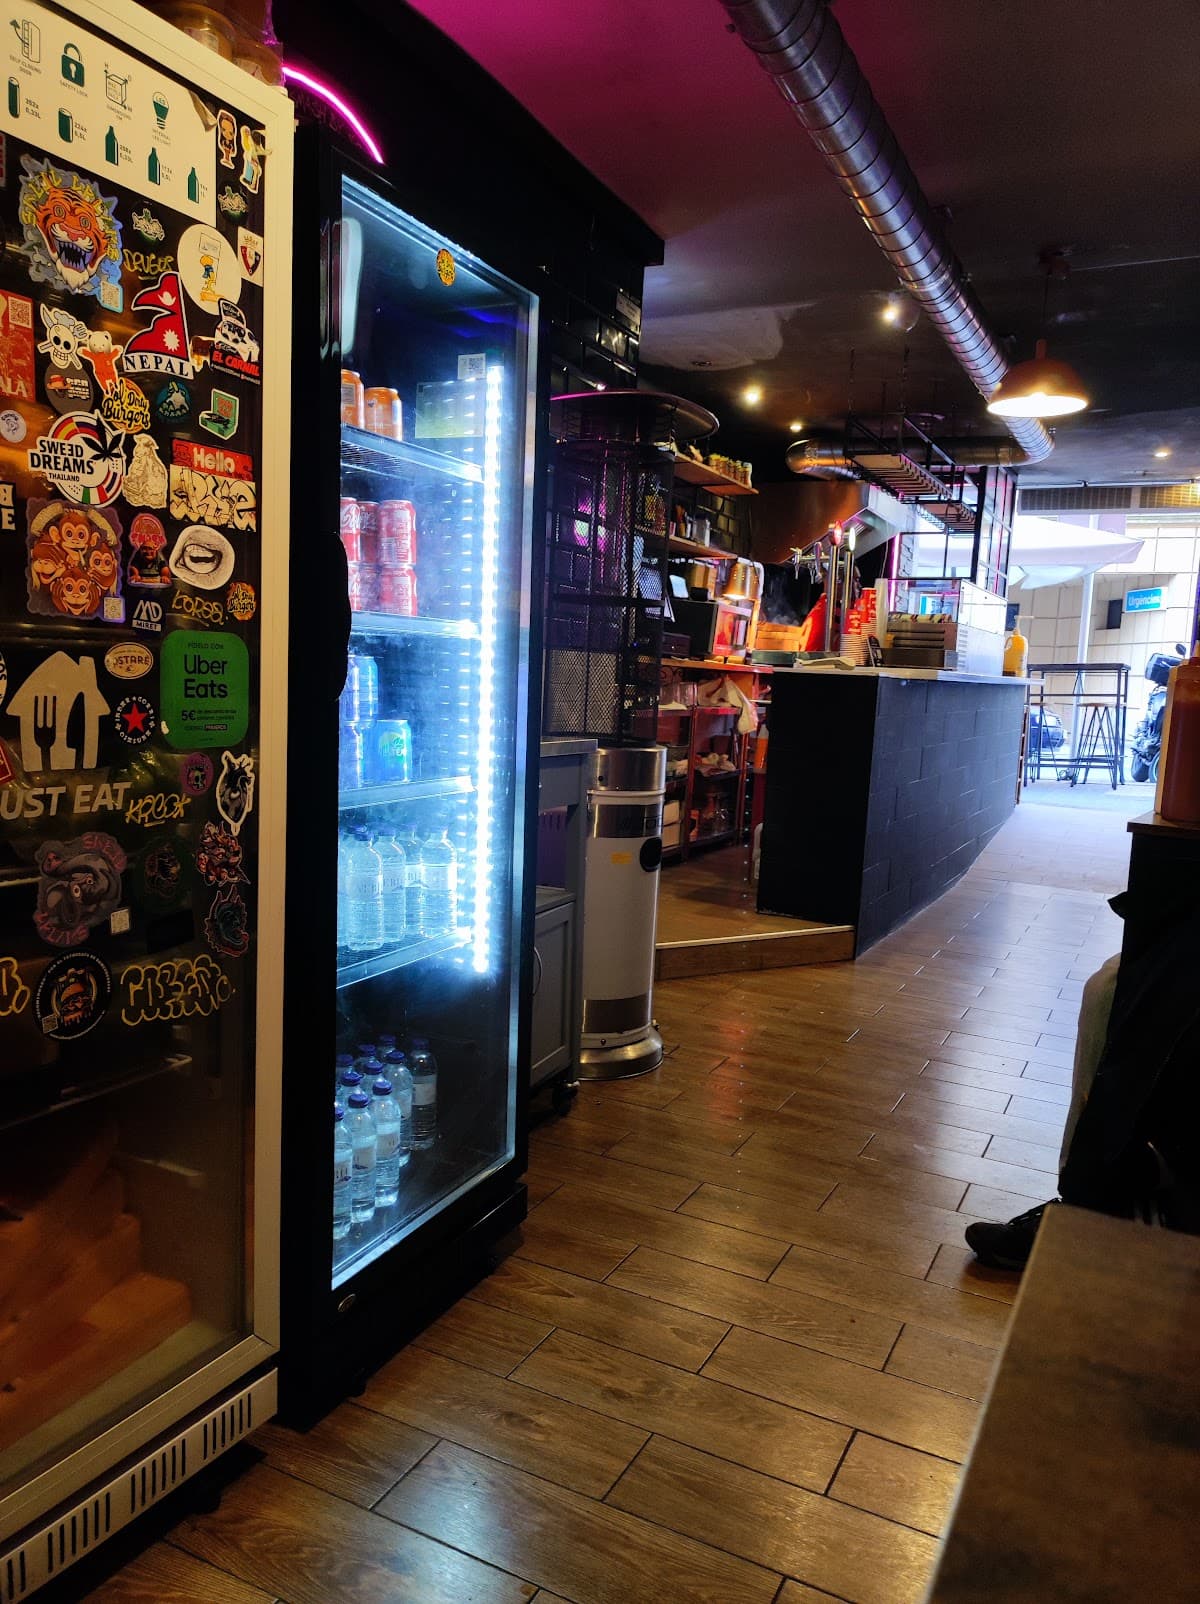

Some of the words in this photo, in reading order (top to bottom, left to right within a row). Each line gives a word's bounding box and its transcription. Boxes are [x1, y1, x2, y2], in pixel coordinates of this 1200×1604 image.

[124, 354, 189, 377] NEPAL
[103, 398, 149, 428] Burgers
[30, 453, 94, 475] DREAMS
[193, 447, 236, 473] Hello
[48, 472, 80, 482] THAILAND
[184, 654, 227, 675] Uber
[184, 678, 228, 698] Eats
[181, 710, 196, 721] 5€
[73, 781, 132, 814] EAT
